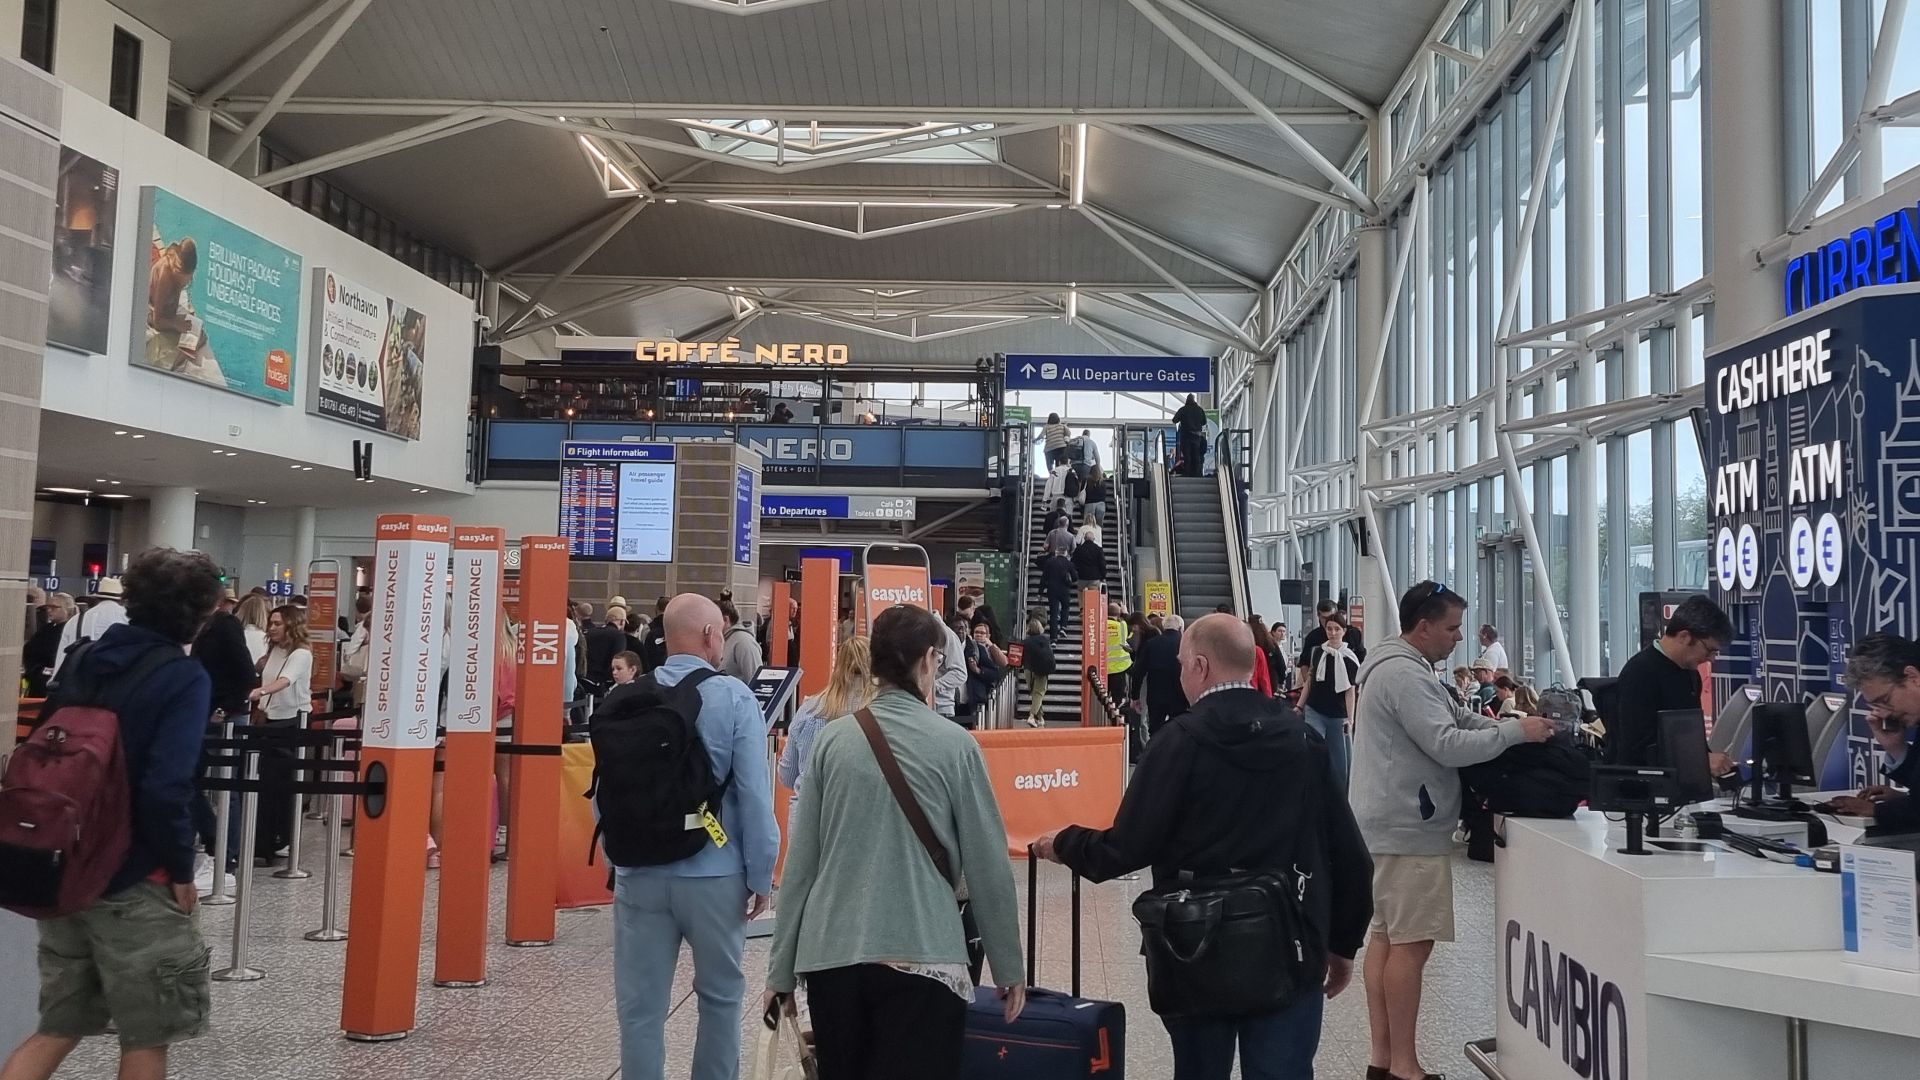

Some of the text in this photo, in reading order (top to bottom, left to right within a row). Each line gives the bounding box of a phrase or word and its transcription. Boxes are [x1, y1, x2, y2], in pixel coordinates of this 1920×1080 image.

[209, 241, 247, 273] BRILLIANT
[248, 259, 281, 287] PACKAGE
[208, 260, 256, 294] HOLIDAYS AT
[207, 279, 257, 313] UNBEATABLE
[339, 284, 378, 319] Northavon
[636, 337, 848, 365] CAFFÈ NERO
[1062, 368, 1196, 383] All Departure Gates
[1717, 328, 1832, 415] CASH HERE
[577, 447, 649, 457] Flight Information
[750, 438, 852, 460] NERO
[638, 471, 666, 479] passenger
[1789, 440, 1842, 505] ATM
[1715, 458, 1758, 517] ATM
[769, 507, 777, 515] to
[780, 506, 827, 517] Departures
[381, 522, 410, 531] easyJet
[416, 523, 448, 534] easyJet
[459, 533, 495, 543] easyJet
[534, 542, 566, 551] easyJet
[45, 577, 58, 590] 10
[90, 581, 97, 591] 7
[270, 582, 278, 594] 8
[284, 584, 291, 595] 5
[871, 585, 924, 603] easyJet
[378, 550, 399, 712] SPECIAL ASSISTANCE
[415, 551, 436, 713] SPECIAL ASSISTANCE
[465, 558, 482, 701] SPECIAL ASSISTANCE
[1088, 608, 1097, 656] easyJet plus
[532, 620, 559, 665] EXIT
[1014, 768, 1079, 793] easyJet
[1505, 919, 1629, 1080] CAMBIO
